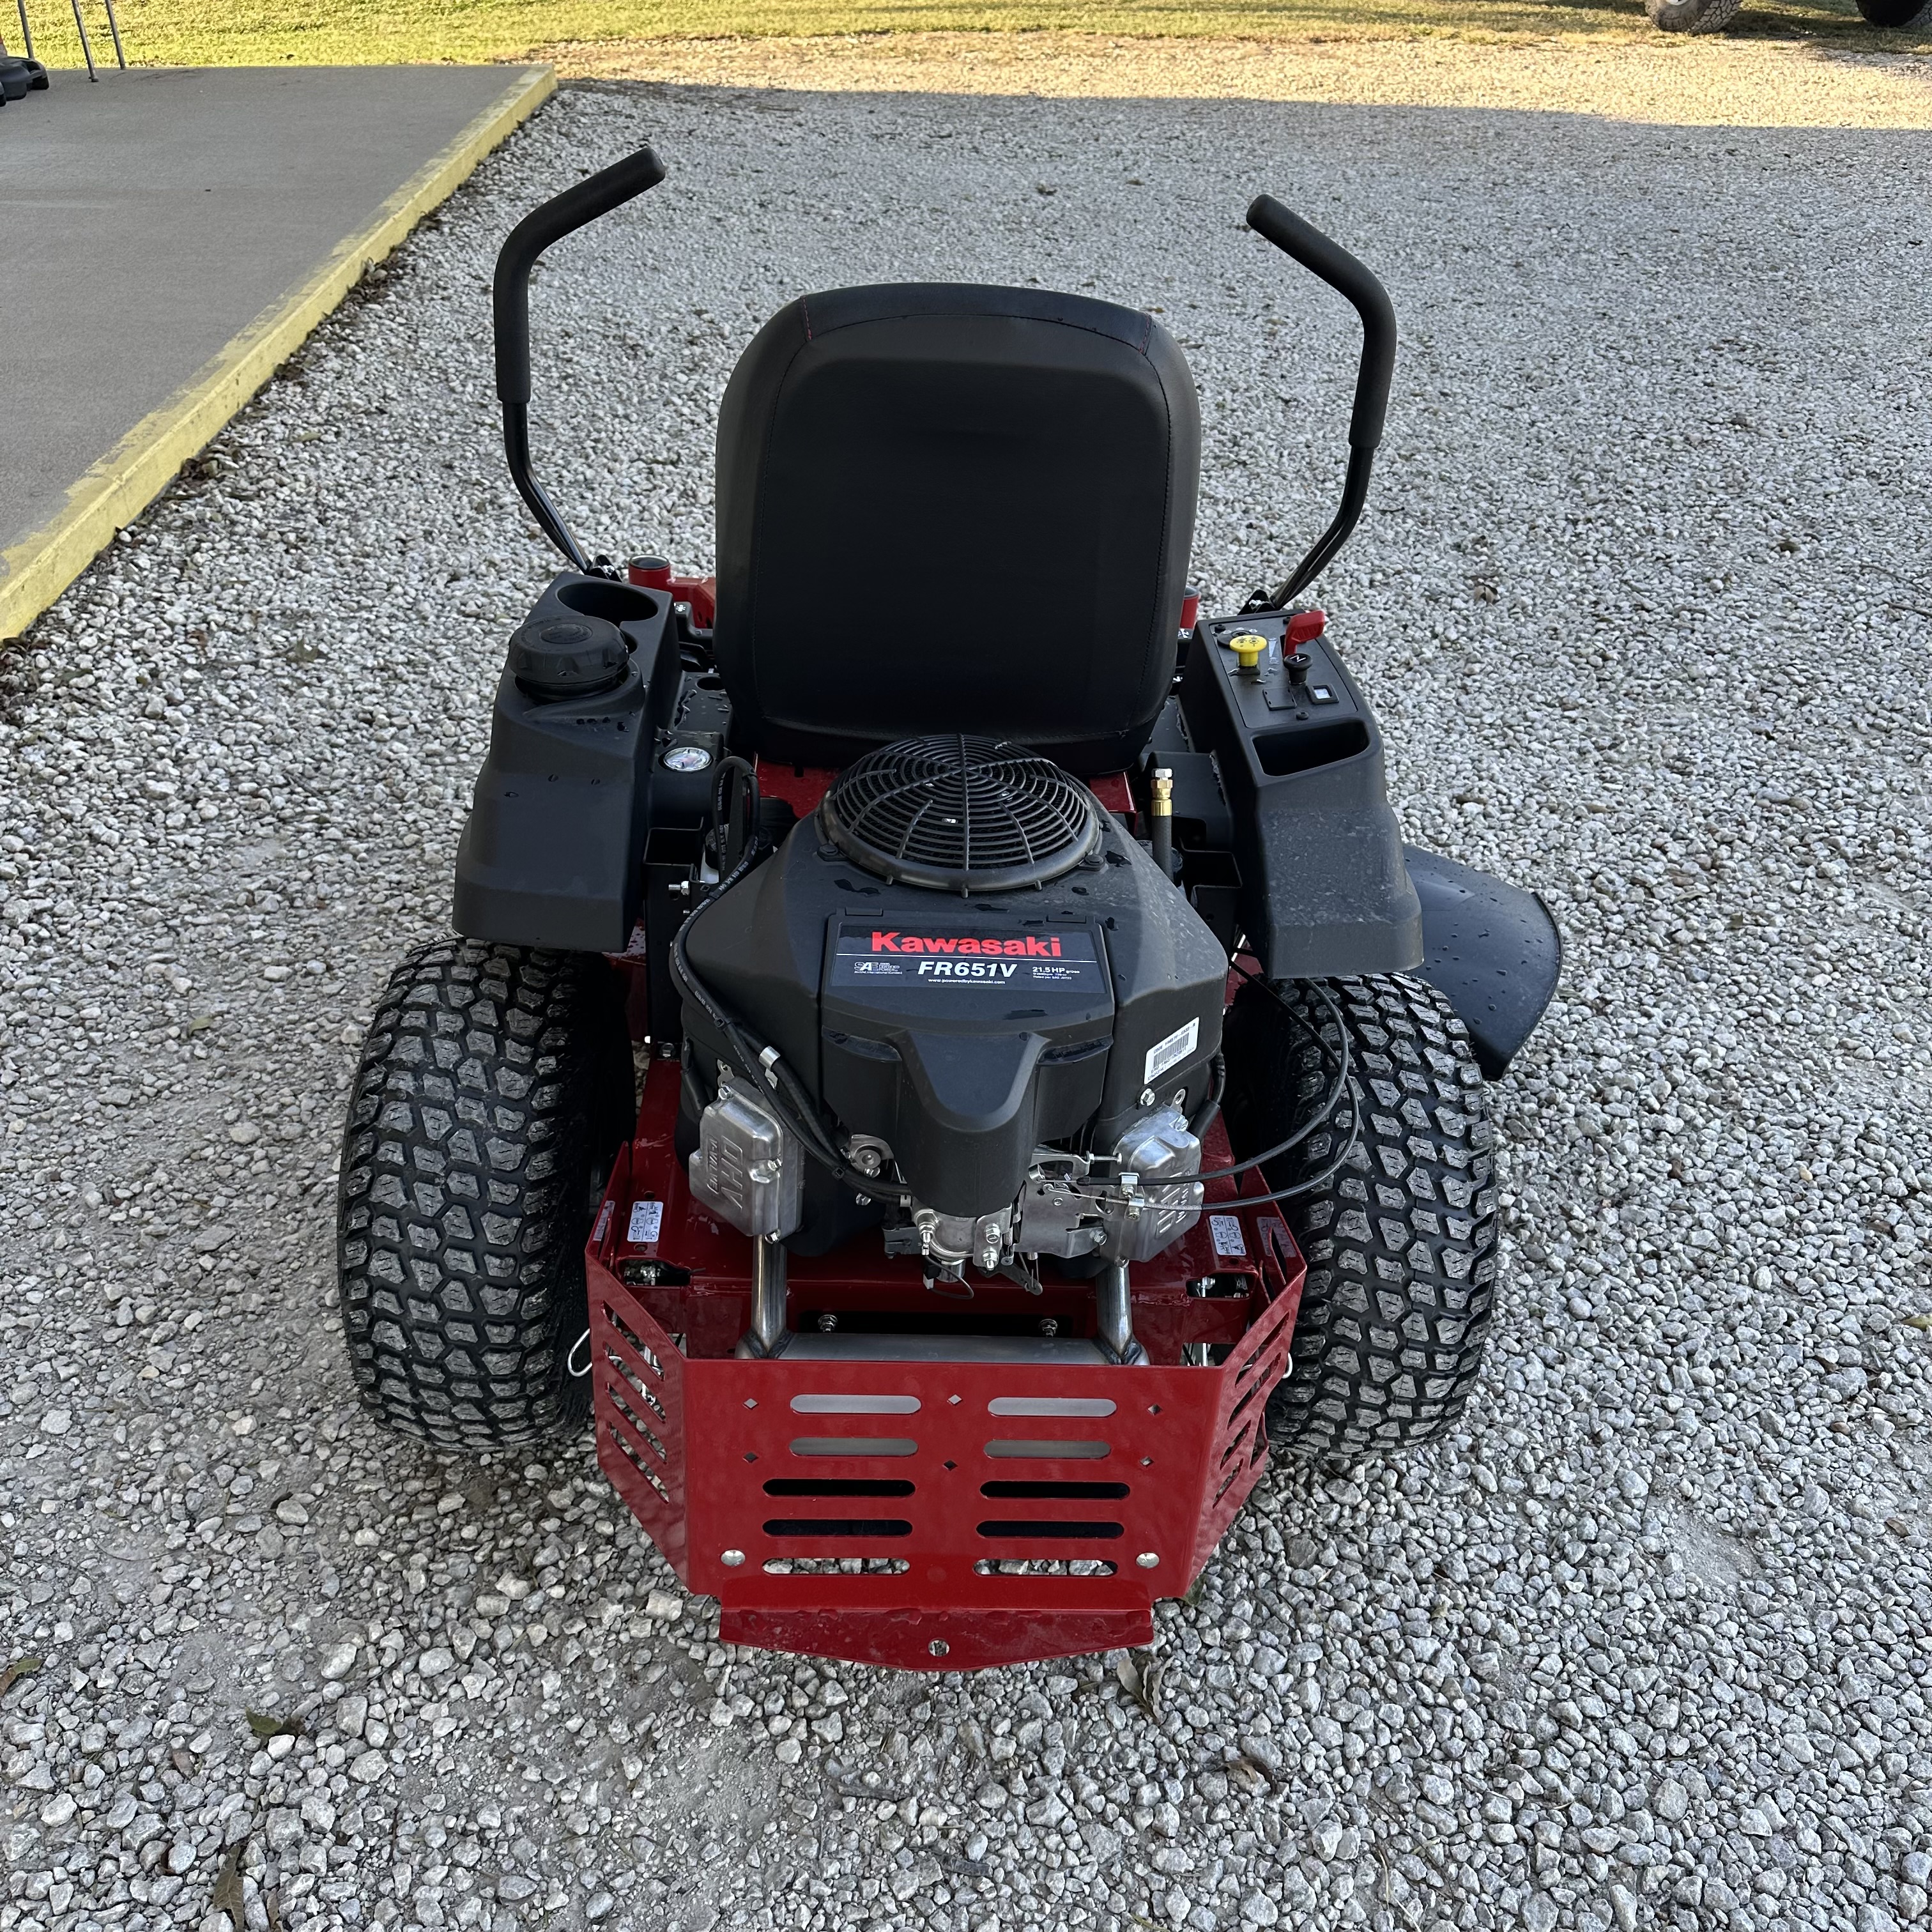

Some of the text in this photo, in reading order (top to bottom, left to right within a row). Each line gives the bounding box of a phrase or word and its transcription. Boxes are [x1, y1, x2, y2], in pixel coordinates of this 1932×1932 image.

[871, 931, 1062, 957] Kawasaki
[917, 961, 1018, 977] FR651V
[721, 1135, 743, 1212] OHV
